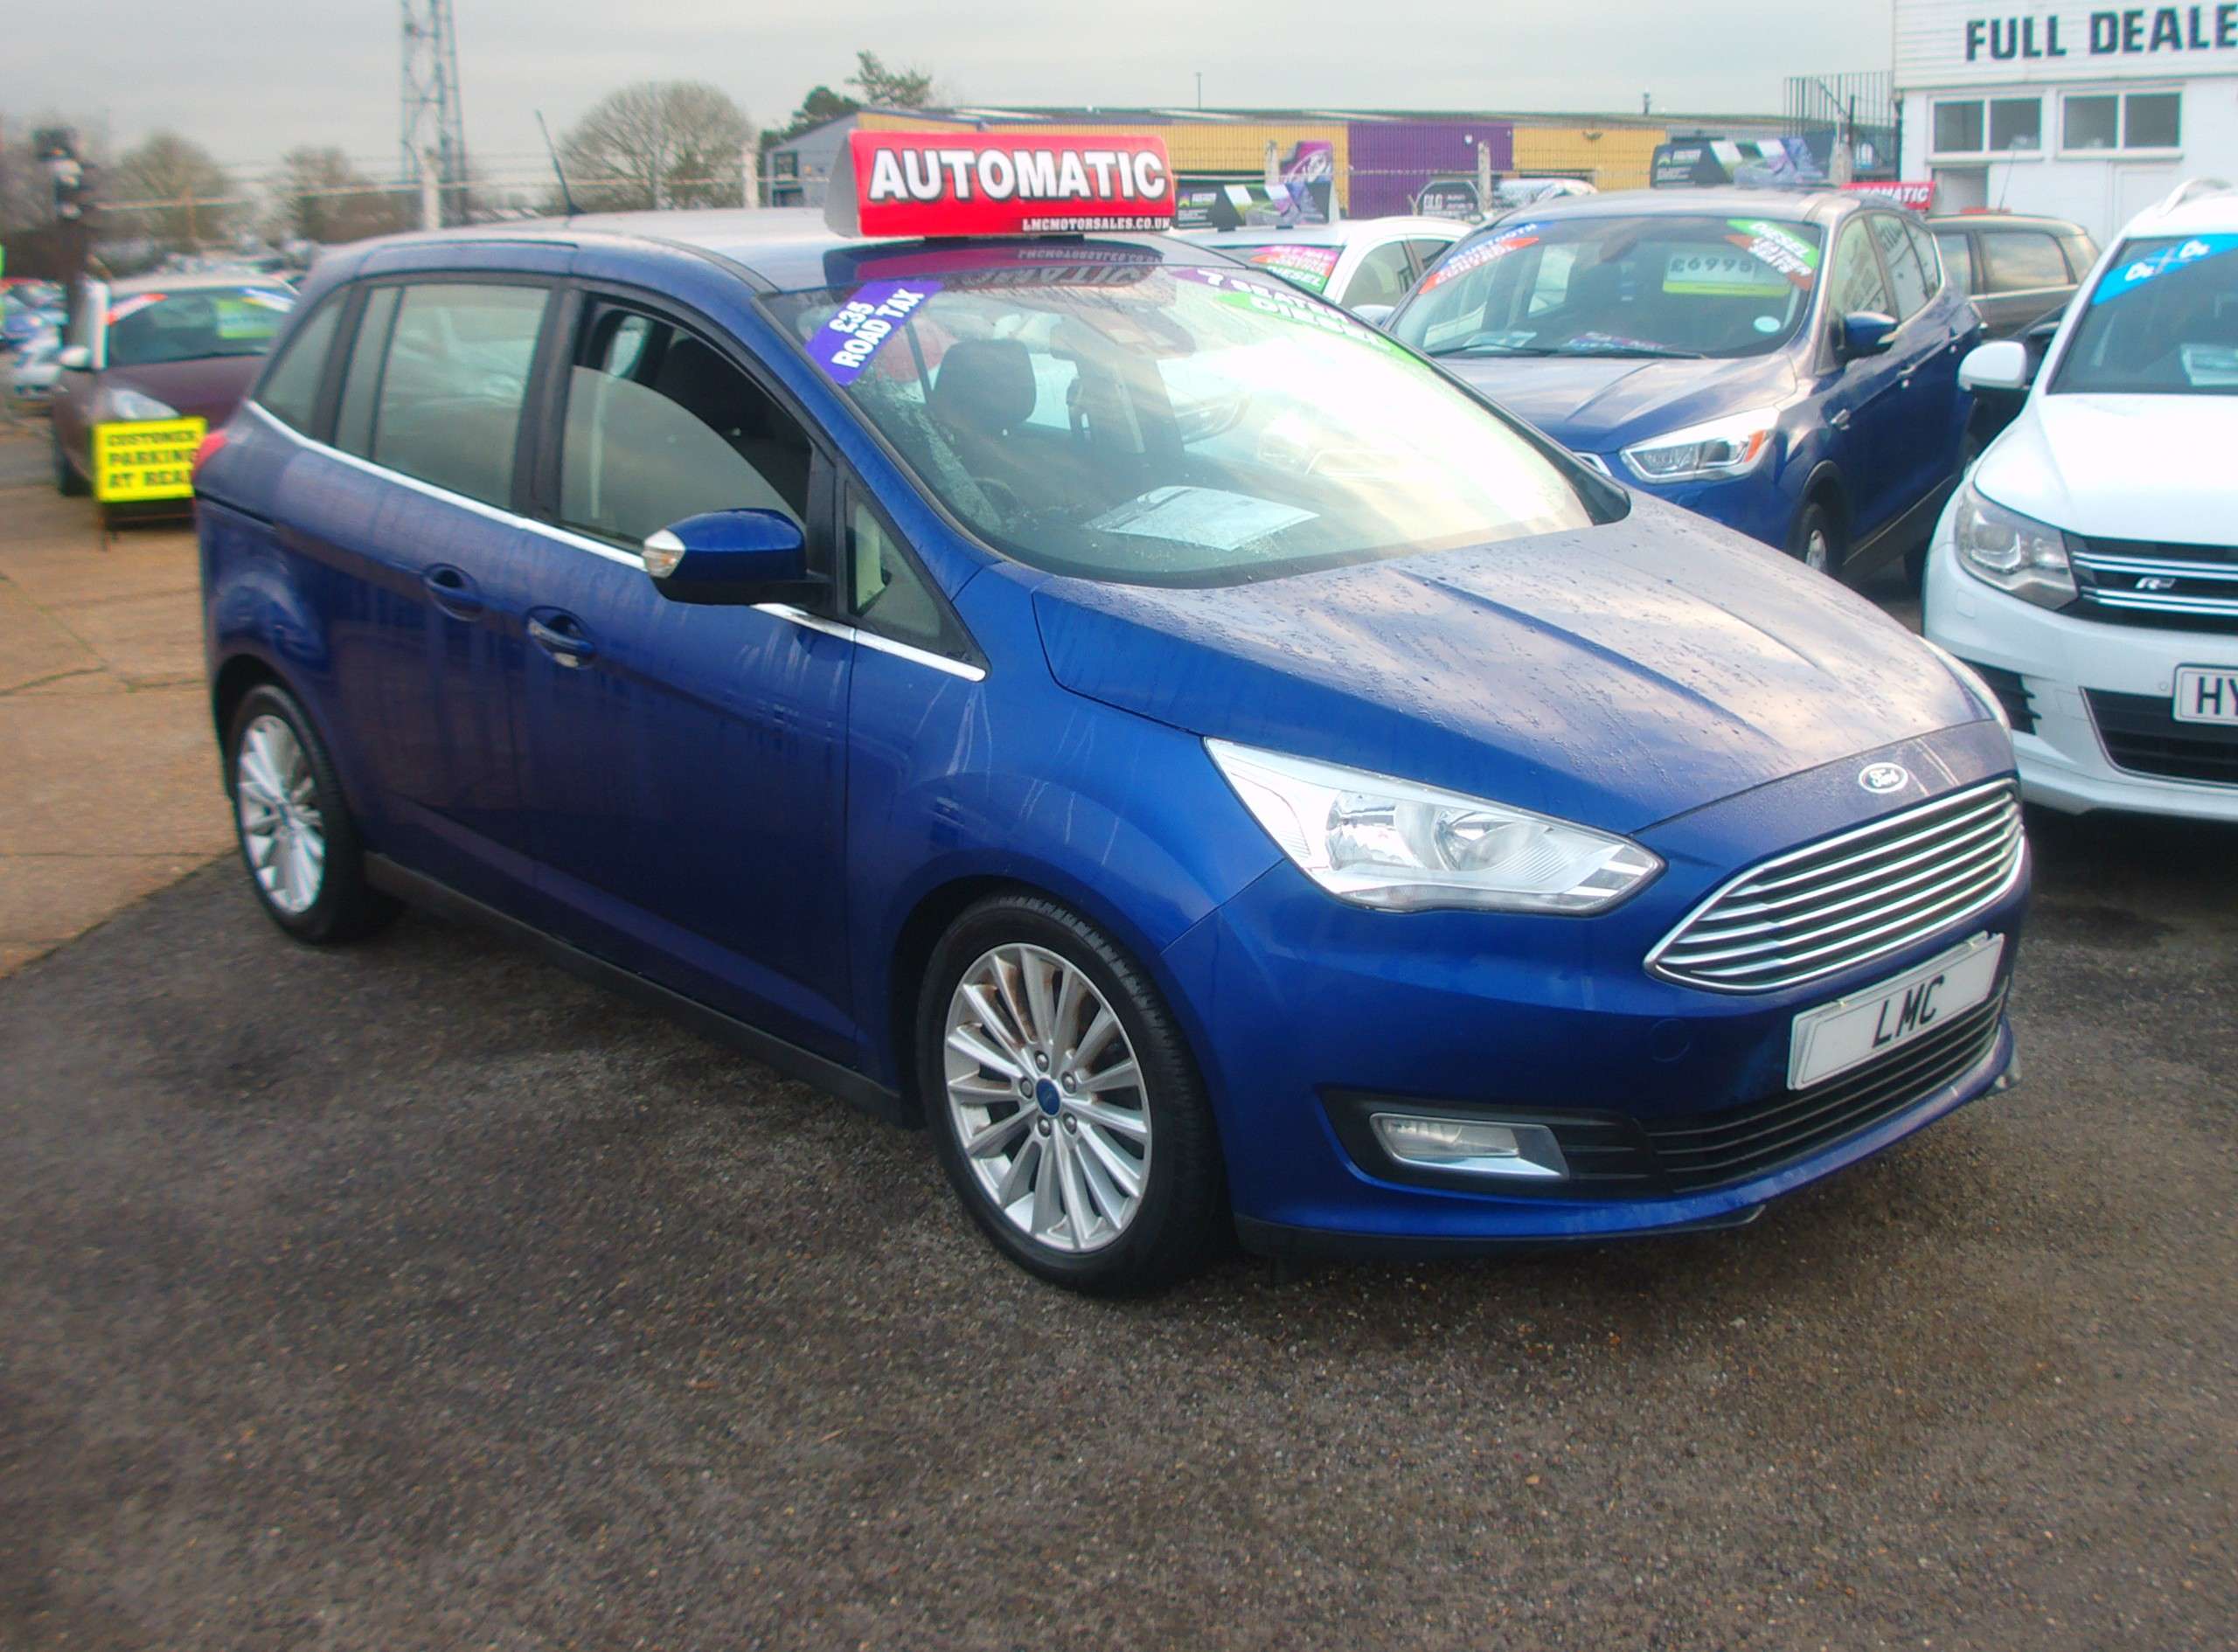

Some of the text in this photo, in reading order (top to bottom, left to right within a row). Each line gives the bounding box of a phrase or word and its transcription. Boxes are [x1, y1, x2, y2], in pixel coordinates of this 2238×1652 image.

[1966, 5, 2238, 61] FULL DEALE
[870, 149, 1166, 199] AUTOMATIC
[1023, 218, 1171, 231] LMCMOTORSALES.CO.UK
[829, 302, 874, 333] £35
[831, 288, 925, 368] ROAD TAX
[1870, 768, 1899, 788] Ford
[1873, 975, 1944, 1048] LMC
